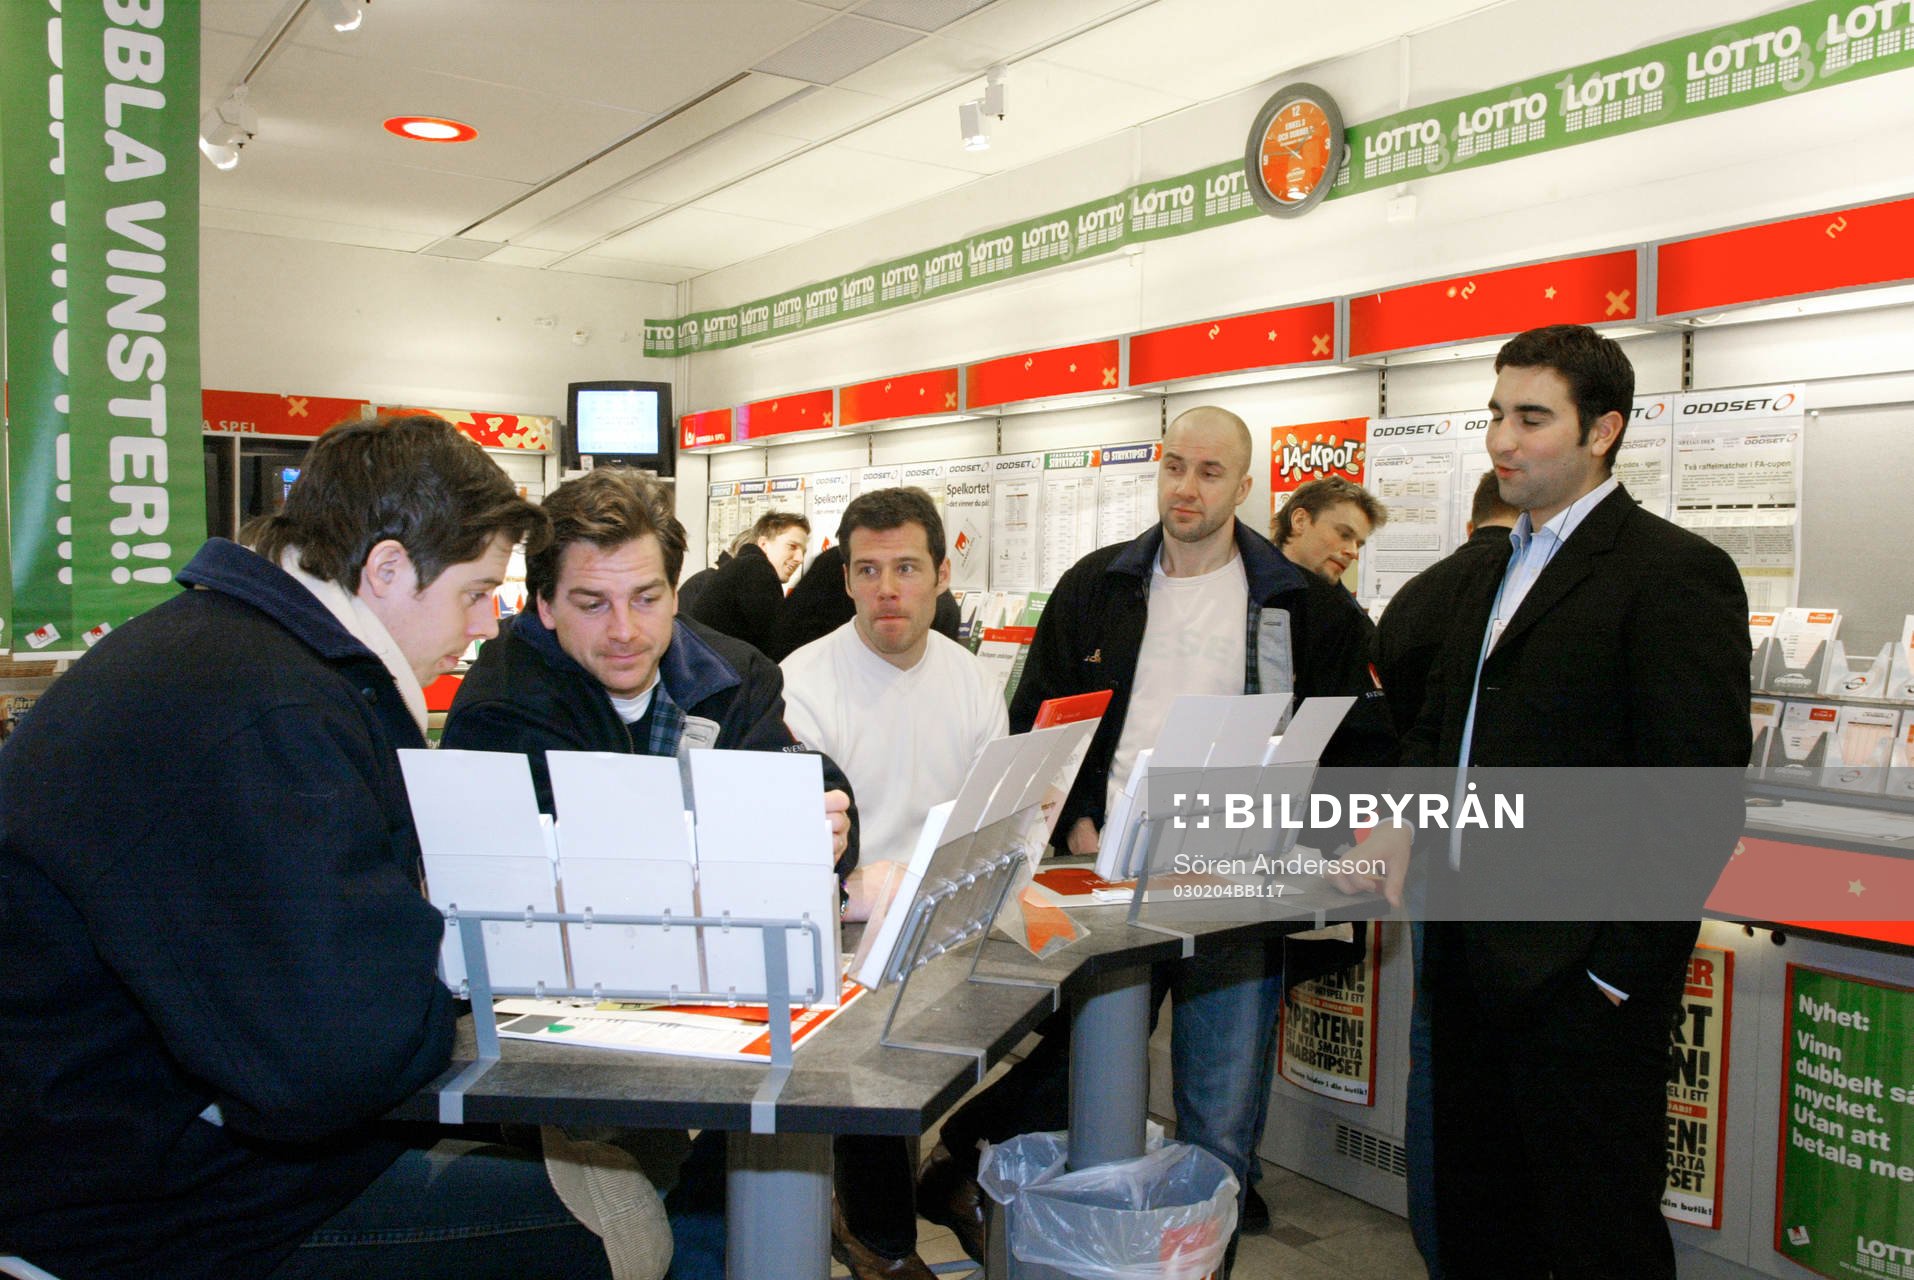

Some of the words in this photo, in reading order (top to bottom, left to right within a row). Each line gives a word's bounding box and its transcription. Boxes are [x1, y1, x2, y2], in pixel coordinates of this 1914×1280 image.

[1291, 105, 1301, 117] 12
[1324, 138, 1331, 150] 3
[704, 314, 738, 332] LOTTO
[741, 305, 769, 325] LOTTO
[773, 296, 801, 317] LOTTO
[806, 286, 838, 307] LOTTO
[843, 275, 875, 298] LOTTO
[881, 264, 919, 287] LOTTO
[925, 250, 963, 276] LOTTO
[970, 236, 1013, 263] LOTTO
[1022, 220, 1070, 249] LOTTO
[1078, 202, 1125, 234] LOTTO
[1133, 184, 1194, 216] LOTTO
[1205, 170, 1248, 200] LOTT
[1364, 119, 1441, 160] LOTTO
[1458, 92, 1548, 137] LOTTO
[1566, 61, 1665, 111] LOTTO
[1687, 26, 1802, 81] LOTTO
[1826, 0, 1914, 45] LOT
[105, 200, 172, 586] VINSTER!!
[1682, 399, 1773, 415] ODDSET
[1373, 424, 1435, 437] ODDSET
[996, 460, 1032, 470] ODDSET
[1280, 440, 1360, 475] JACKPOT
[863, 472, 892, 480] ODDSET
[905, 468, 937, 477] ODDSET
[949, 463, 982, 473] ODDSET
[946, 482, 990, 497] Spelkortet
[814, 494, 849, 505] Spelkortet
[1799, 994, 1870, 1032] Nyhet:
[1318, 1039, 1363, 1061] SMARTA
[1797, 1029, 1842, 1062] Vinn
[1796, 1057, 1883, 1099] dubbelt
[1690, 1089, 1708, 1103] ETT
[1795, 1082, 1885, 1124] mycket.
[1794, 1103, 1844, 1139] Utan
[1851, 1126, 1891, 1152] att
[1792, 1128, 1862, 1170] betala
